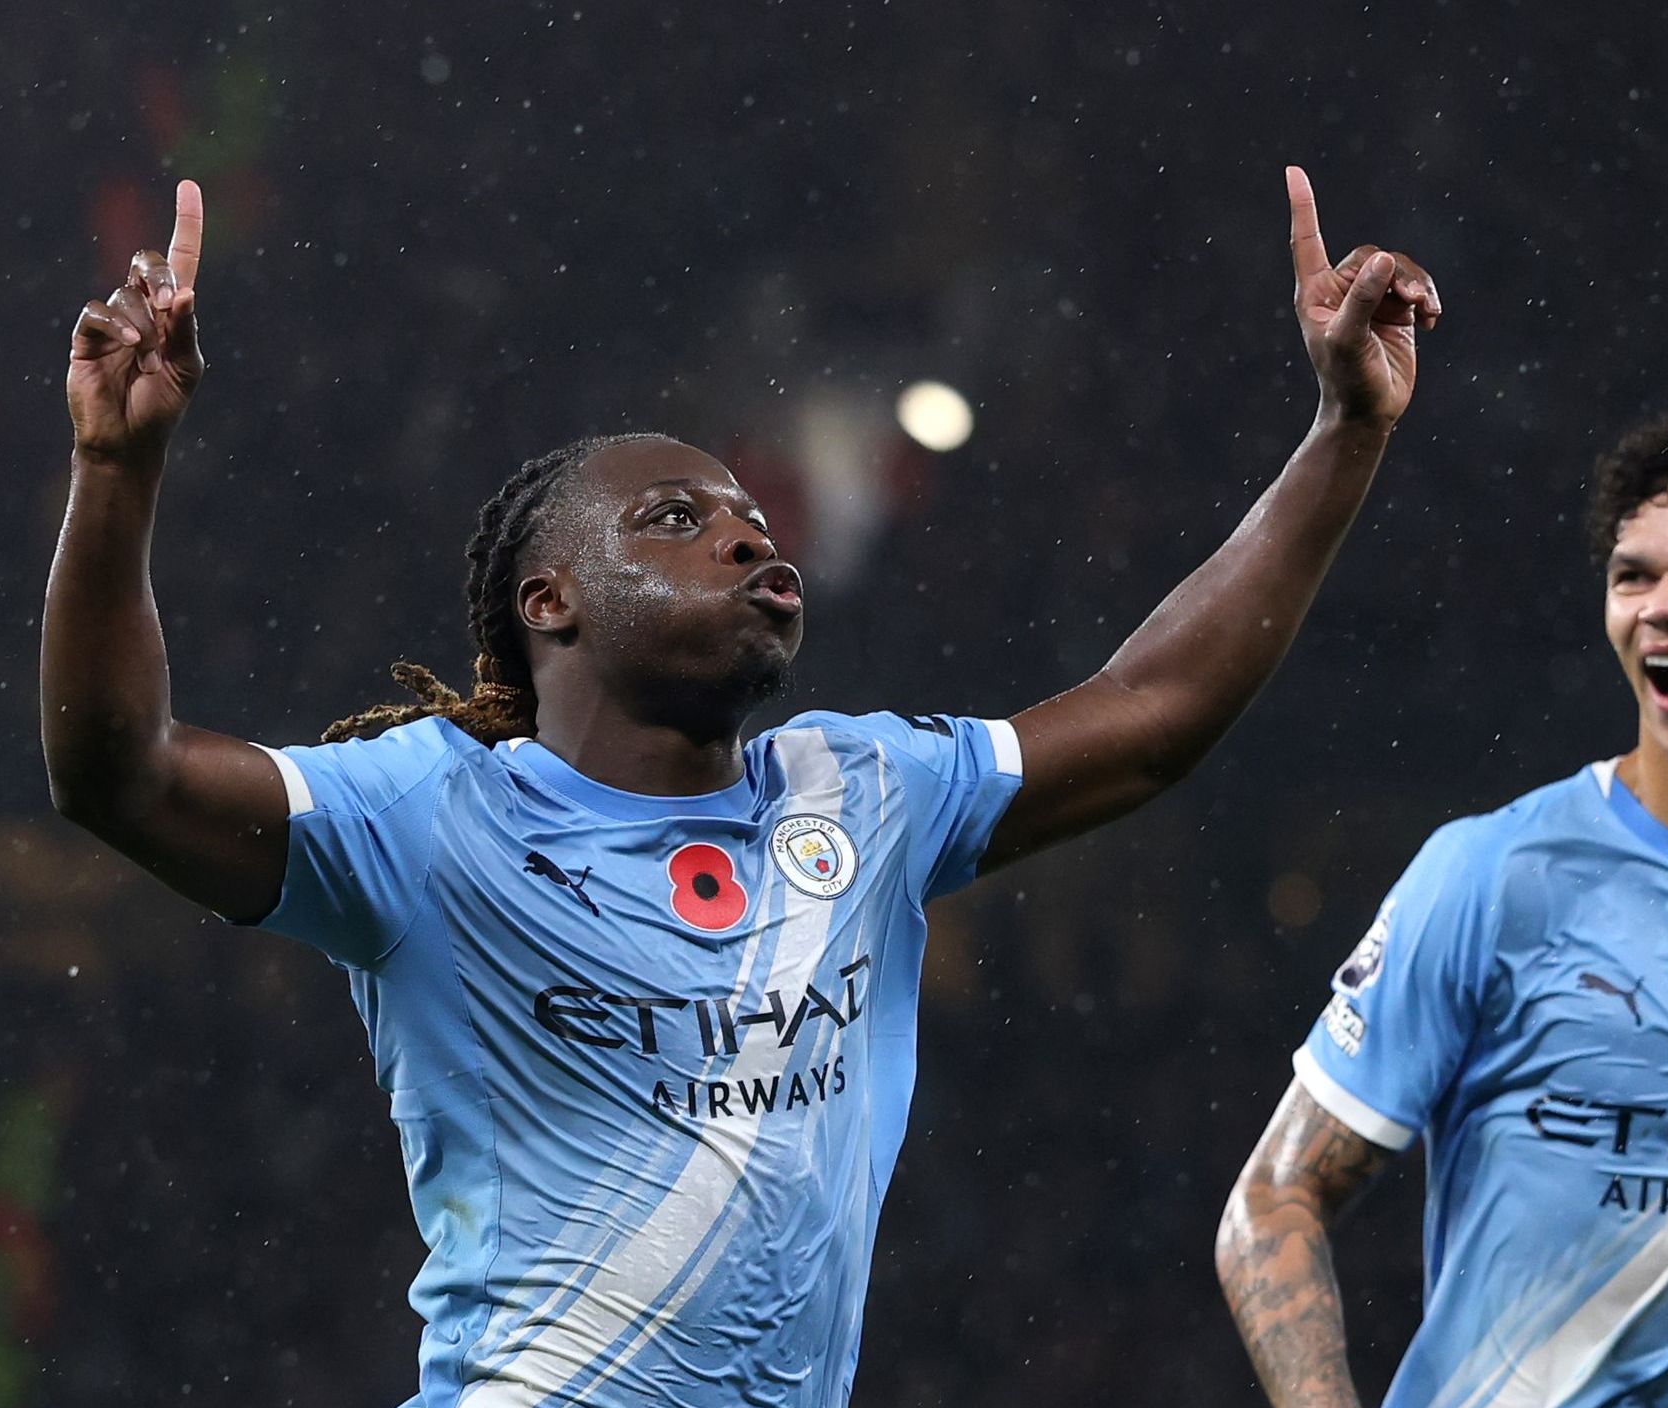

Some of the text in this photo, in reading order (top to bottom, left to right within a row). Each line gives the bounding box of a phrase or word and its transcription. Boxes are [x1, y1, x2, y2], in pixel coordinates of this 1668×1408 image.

[775, 819, 835, 853] MANCHESTER
[822, 879, 844, 893] CITY
[652, 1056, 846, 1119] AIRWAYS
